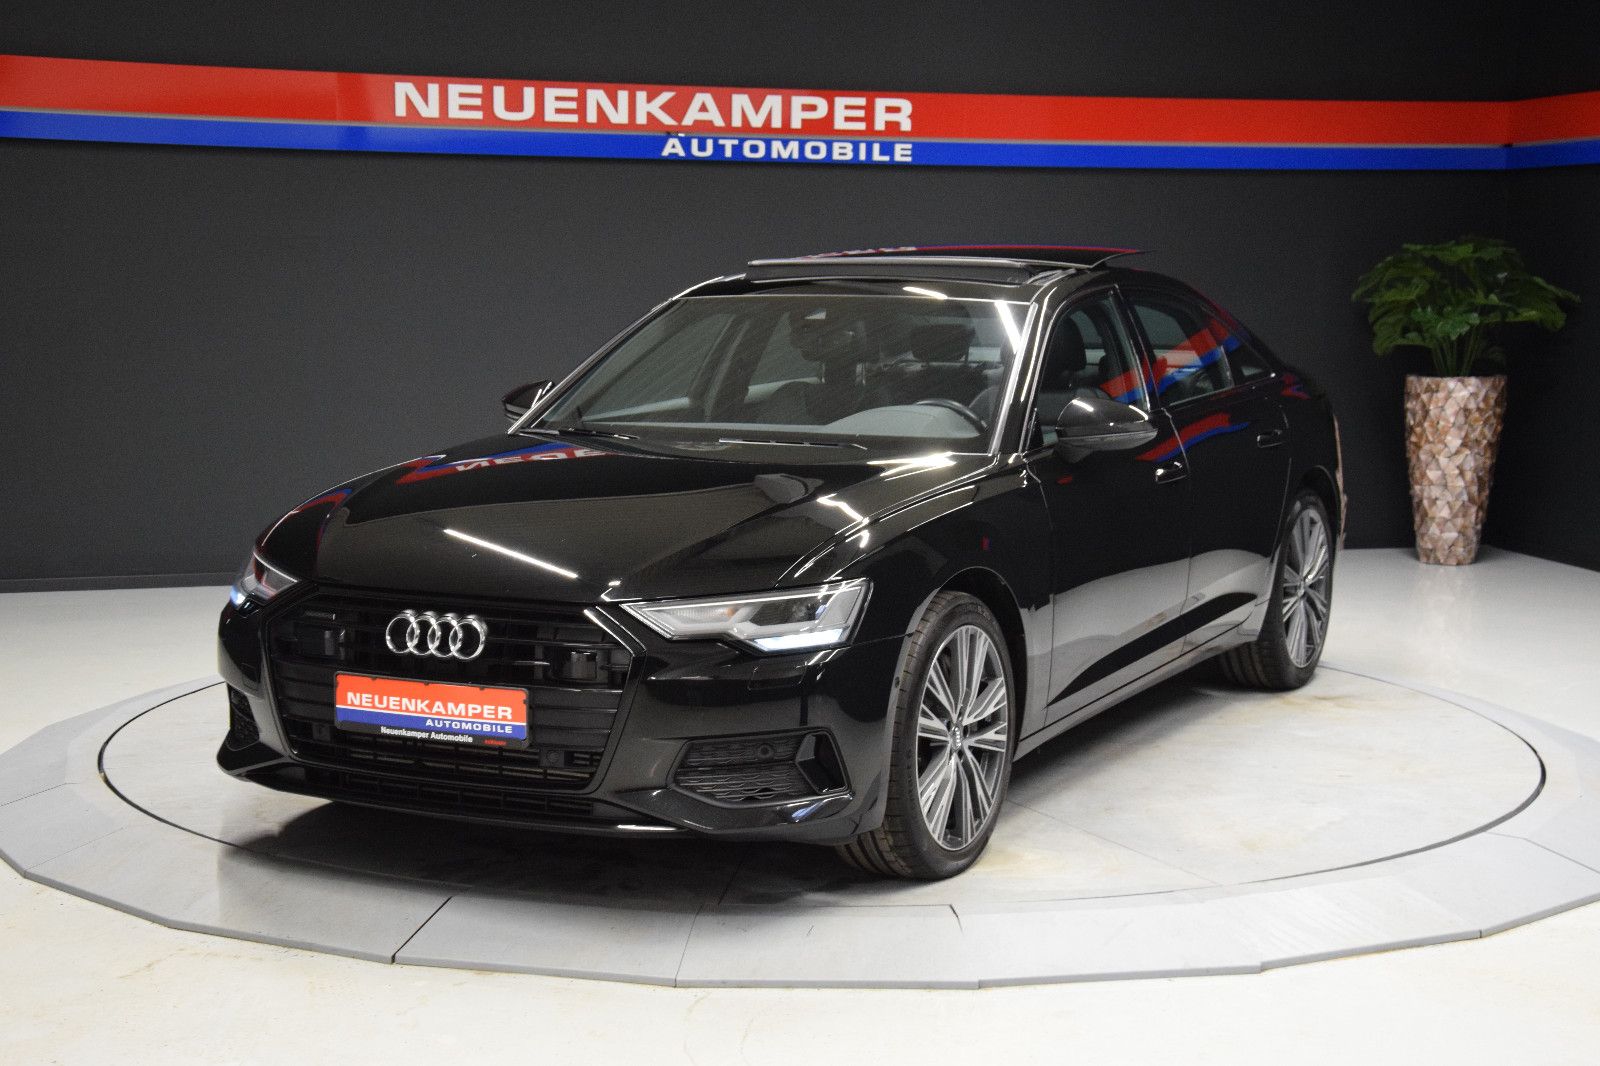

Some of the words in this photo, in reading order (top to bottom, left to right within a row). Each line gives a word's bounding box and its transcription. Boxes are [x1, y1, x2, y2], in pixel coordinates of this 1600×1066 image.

[394, 81, 913, 132] NEUENKAMPER
[661, 136, 914, 163] AUTOMOBILE
[347, 691, 513, 720] NEUENKAMPER
[380, 726, 430, 739] Neuenkamper
[430, 731, 474, 743] Automobile
[425, 718, 513, 734] AUTOMOBILE
